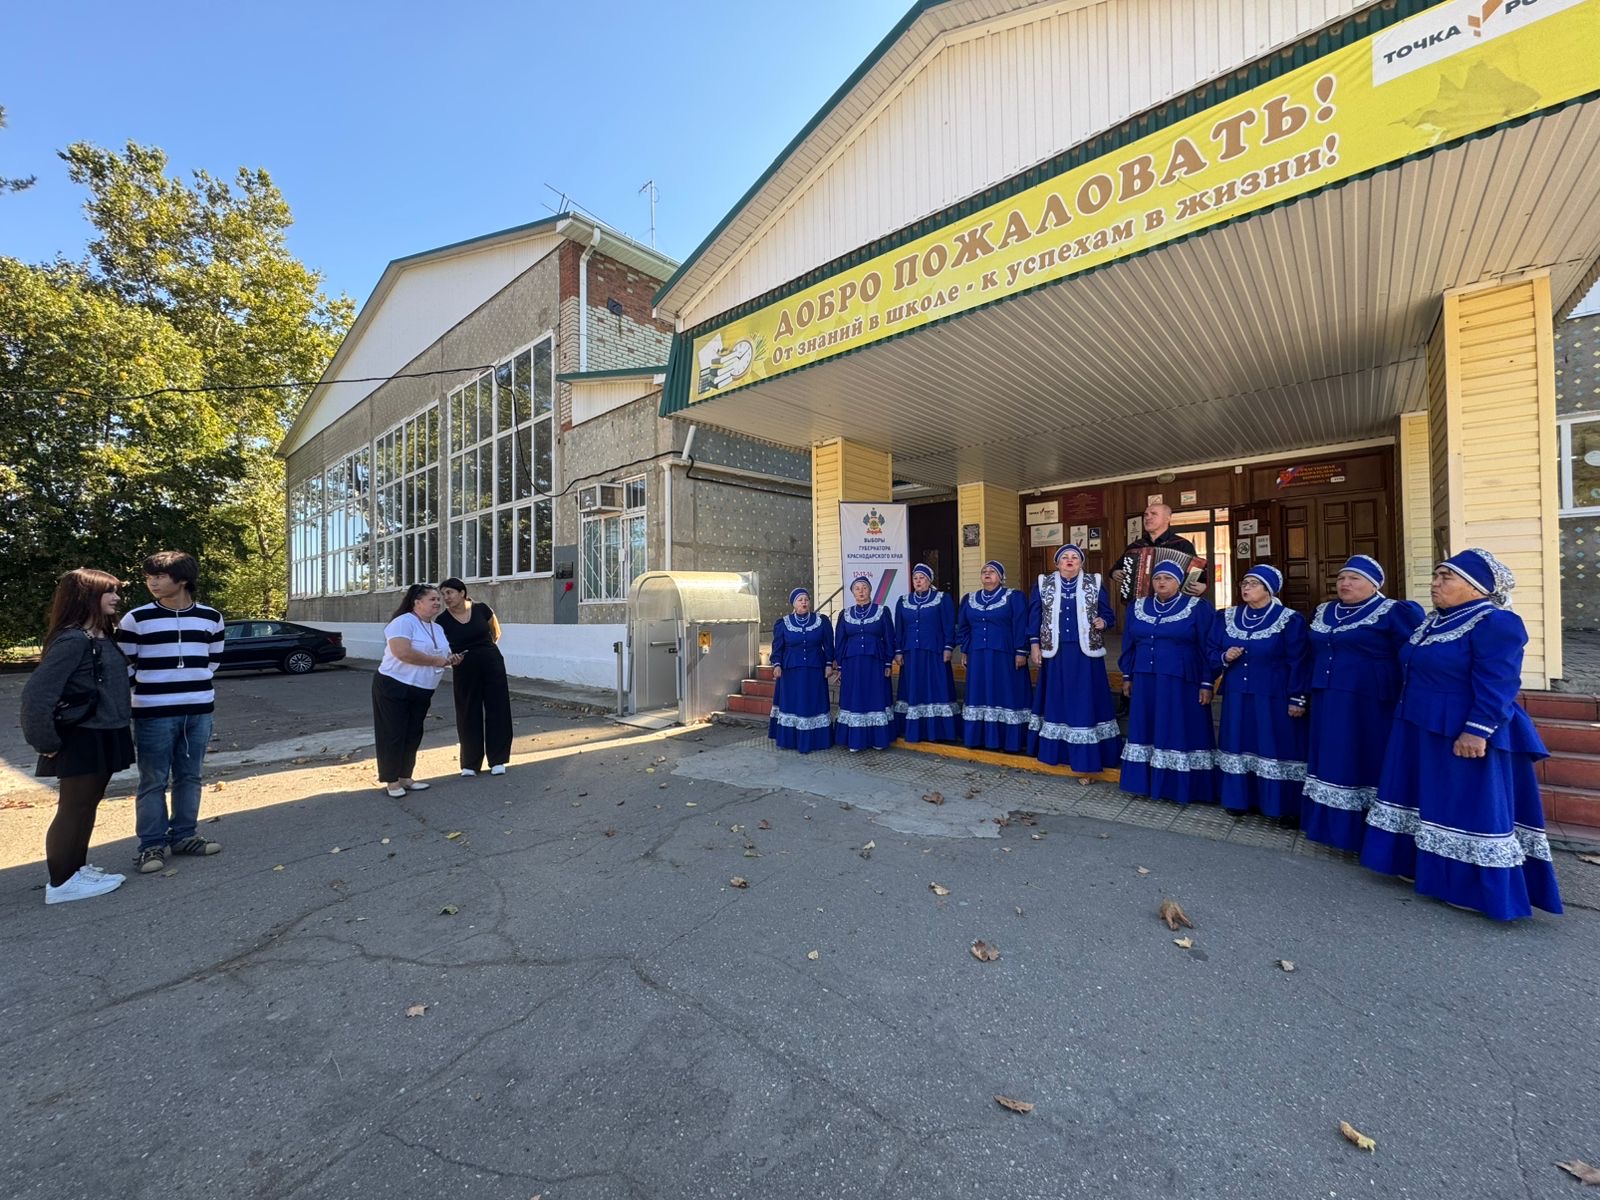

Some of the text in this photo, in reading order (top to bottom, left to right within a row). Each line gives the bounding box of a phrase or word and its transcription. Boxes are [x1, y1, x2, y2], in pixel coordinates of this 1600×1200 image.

[1383, 25, 1461, 64] ТОЧКА
[772, 345, 792, 365] От
[797, 318, 863, 355] знаний
[868, 315, 880, 331] в
[886, 285, 959, 325] школе
[981, 270, 999, 291] к
[1006, 219, 1134, 286] успехам
[1145, 209, 1165, 232] в
[1175, 134, 1338, 220] жизни!
[774, 75, 1335, 342] ДОБРО ПОЖАЛОВАТЬ!
